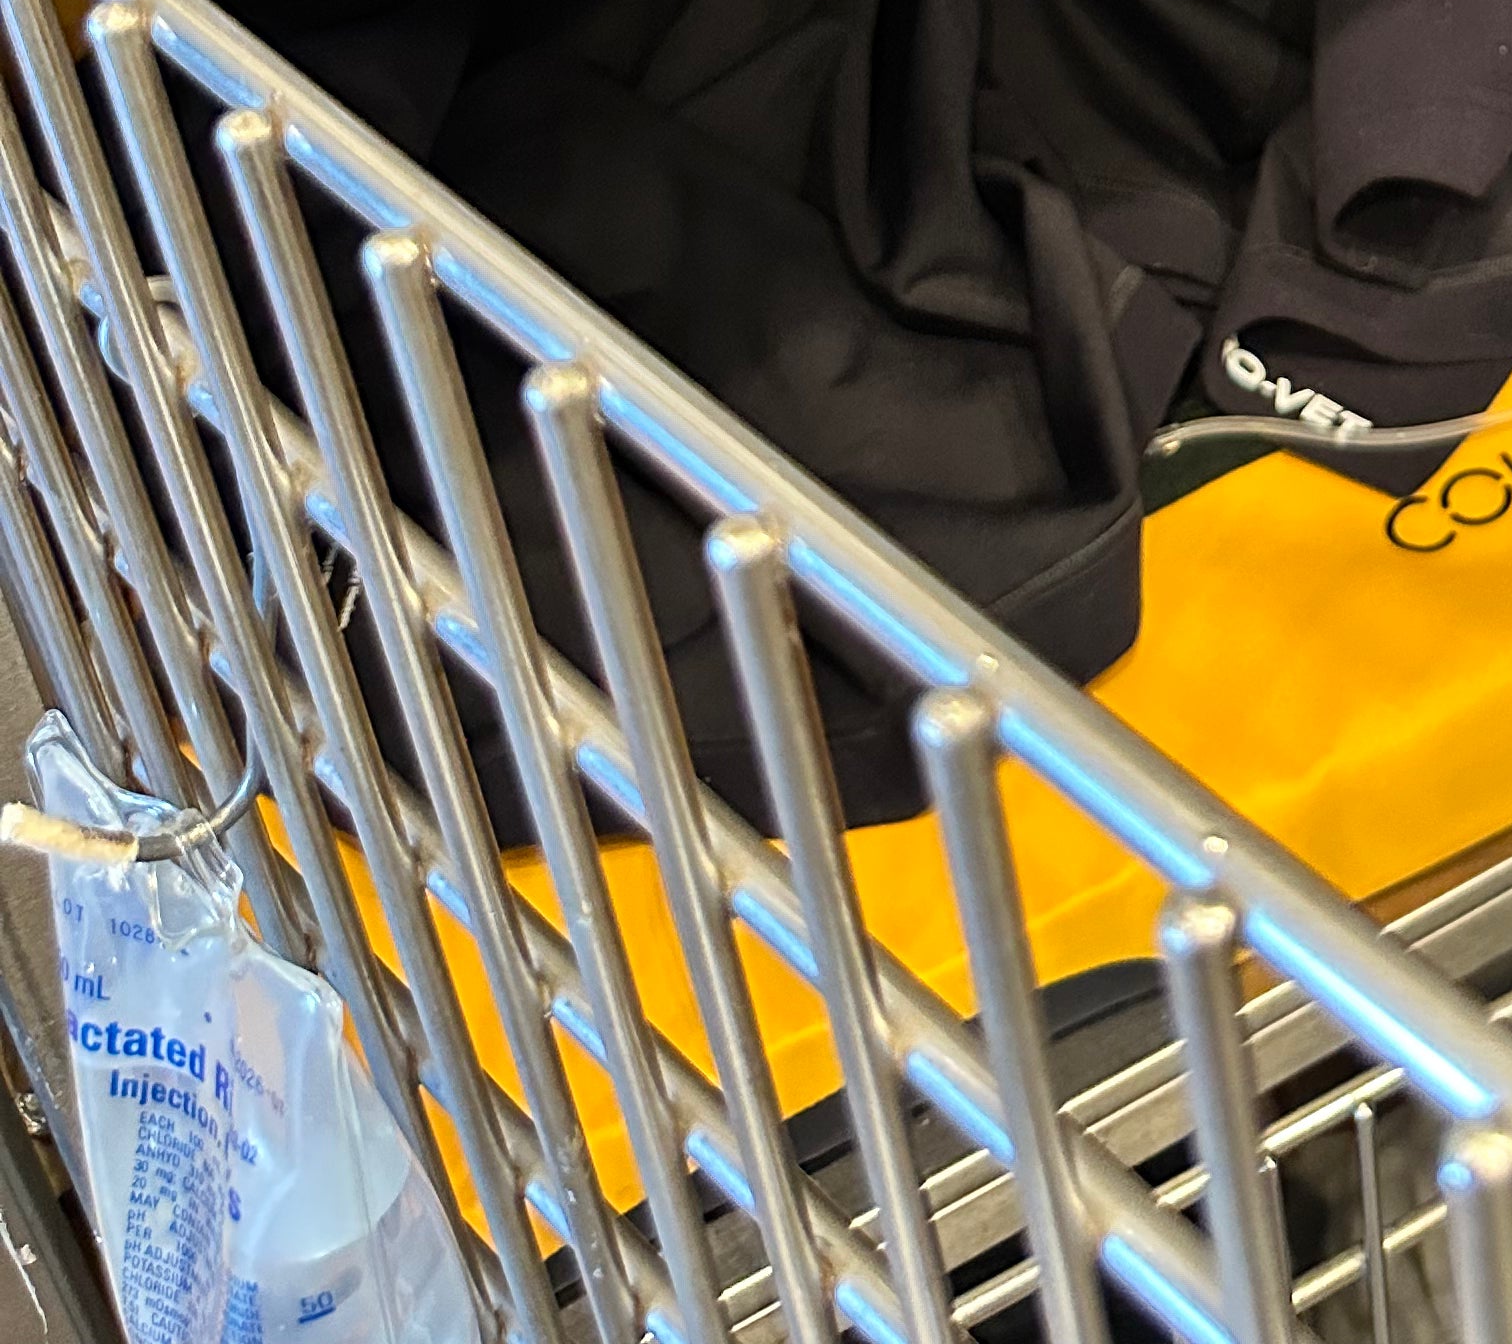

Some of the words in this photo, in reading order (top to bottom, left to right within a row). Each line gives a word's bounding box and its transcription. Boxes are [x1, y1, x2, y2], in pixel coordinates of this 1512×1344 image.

[74, 972, 111, 1001] mL
[67, 1008, 206, 1083] actated
[129, 1189, 160, 1210] MAY
